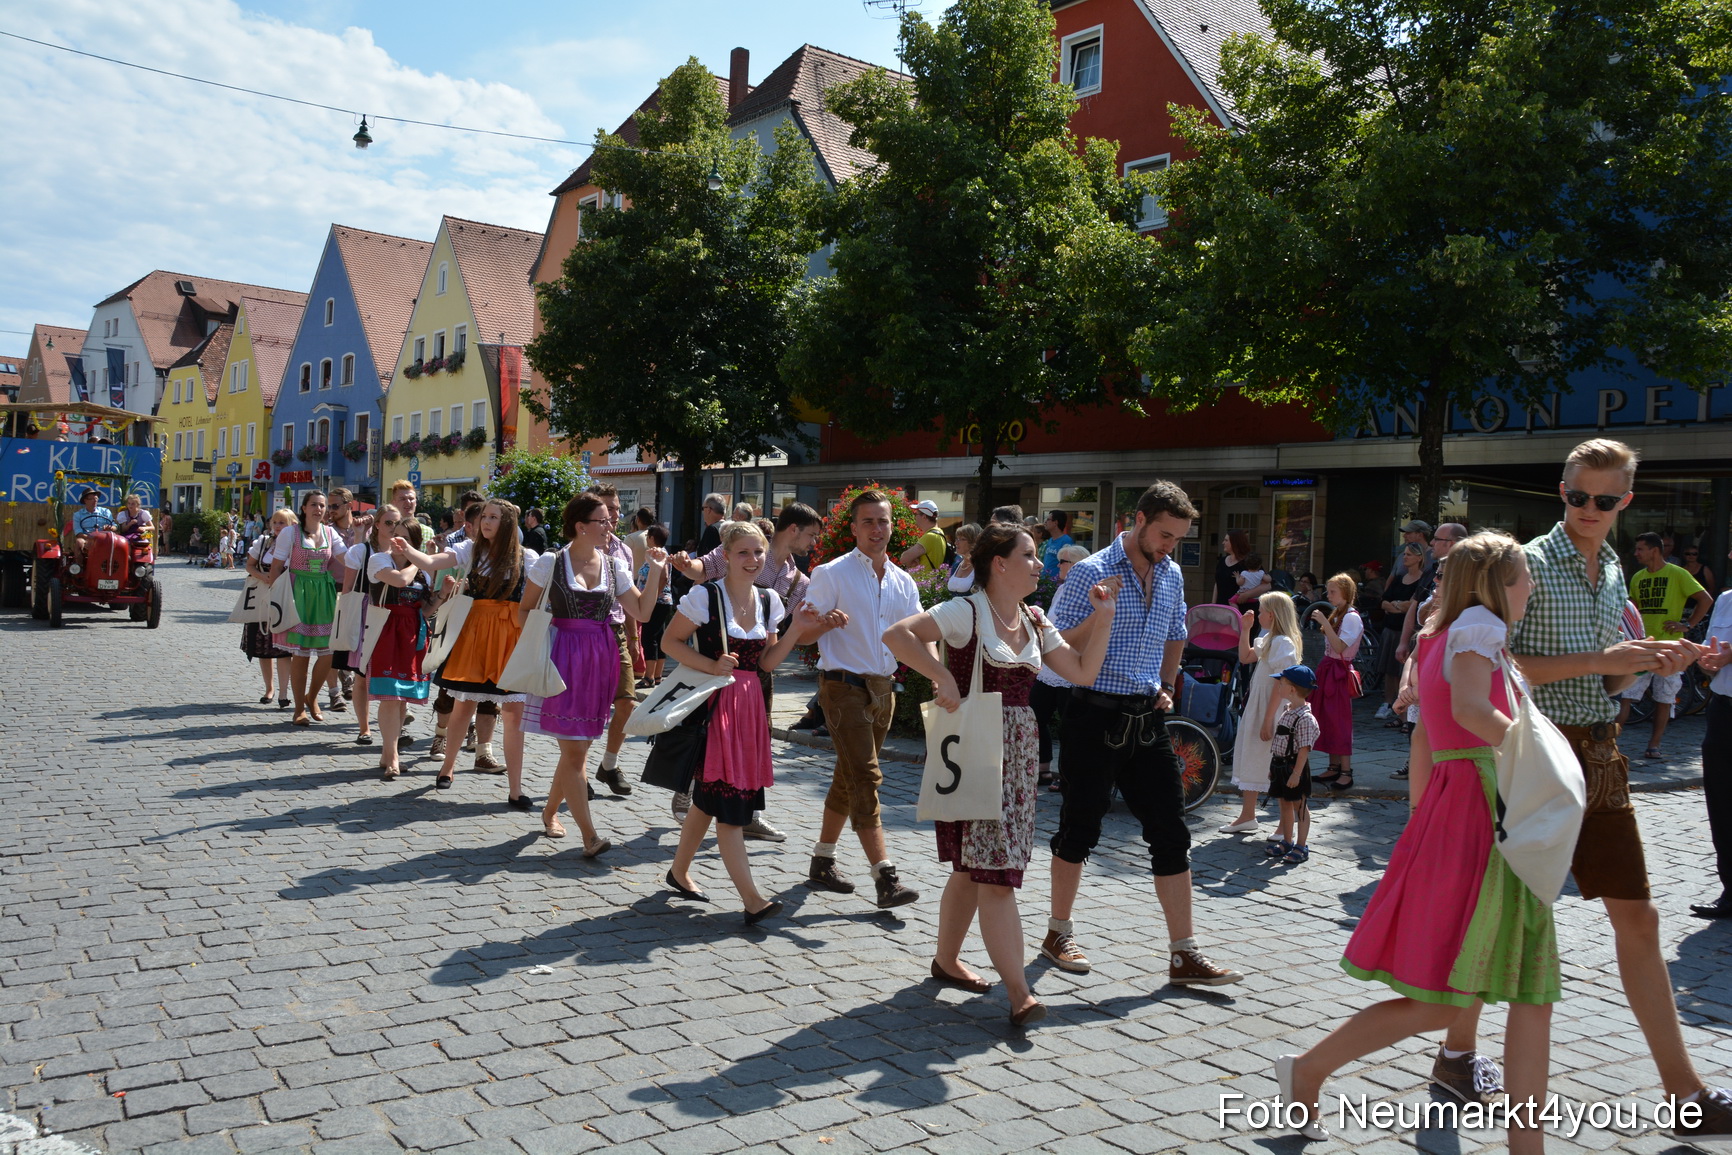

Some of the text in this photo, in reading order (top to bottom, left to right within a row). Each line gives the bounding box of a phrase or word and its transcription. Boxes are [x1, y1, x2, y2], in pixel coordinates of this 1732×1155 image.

[179, 416, 192, 428] HOTEL
[1639, 576, 1668, 589] ICH BIN
[243, 586, 258, 611] E
[1639, 588, 1650, 599] SO
[935, 734, 962, 795] S
